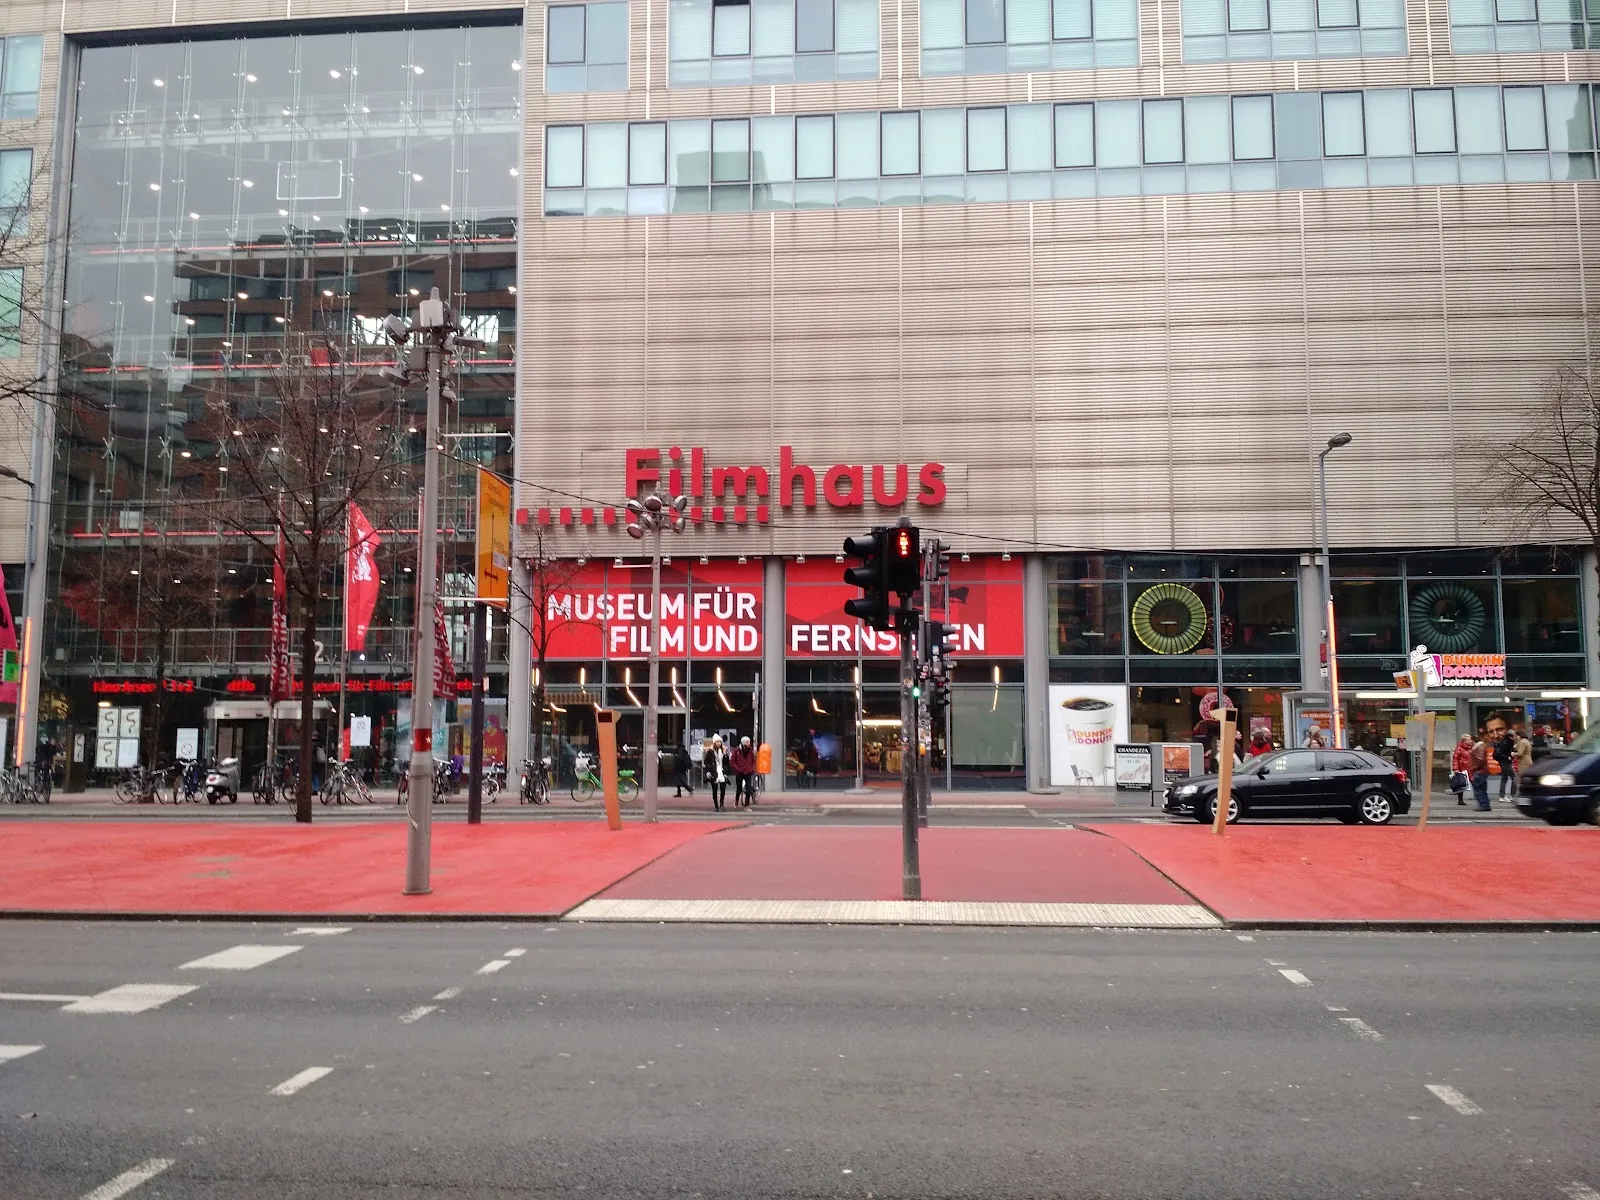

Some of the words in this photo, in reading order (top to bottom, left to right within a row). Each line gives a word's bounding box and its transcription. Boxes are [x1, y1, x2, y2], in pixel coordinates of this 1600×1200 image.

[626, 446, 947, 508] Filmhaus
[547, 593, 685, 621] MUSEUM
[693, 586, 757, 621] FÜR
[610, 625, 685, 653] FILM
[693, 625, 758, 653] UND
[791, 623, 985, 652] FERNSEN
[1442, 665, 1504, 679] DONUTS
[1443, 679, 1475, 687] COFFEE
[1480, 679, 1504, 687] MORE
[290, 681, 341, 693] Mseum
